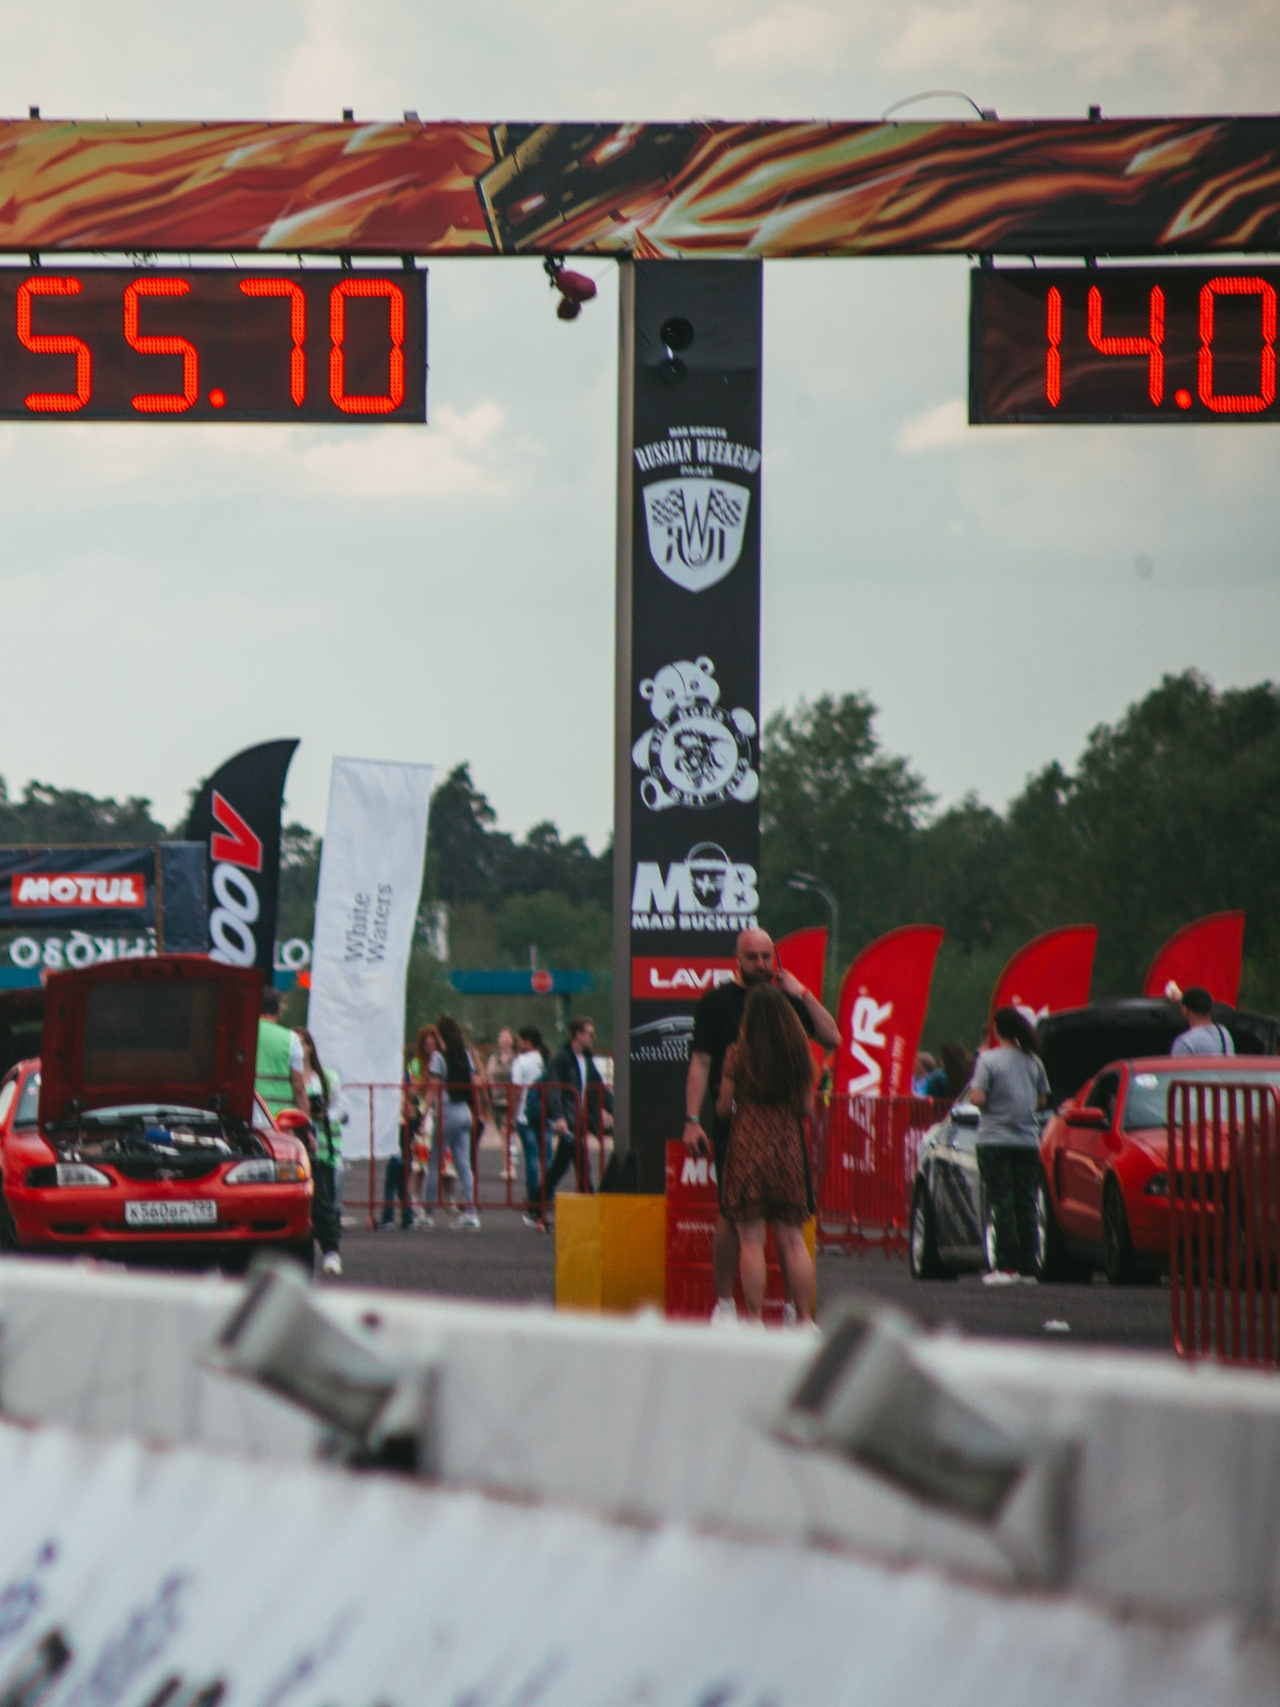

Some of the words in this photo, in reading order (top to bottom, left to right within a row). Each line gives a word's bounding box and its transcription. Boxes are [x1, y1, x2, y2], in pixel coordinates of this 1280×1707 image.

[1046, 276, 1277, 413] 14.0
[633, 439, 692, 472] RUSSIAN
[696, 438, 761, 474] WEEKEND
[18, 877, 138, 903] MOTUL
[344, 891, 371, 962] White
[367, 882, 394, 964] Waters
[631, 913, 676, 931] MAD
[679, 913, 759, 931] BUCKETS
